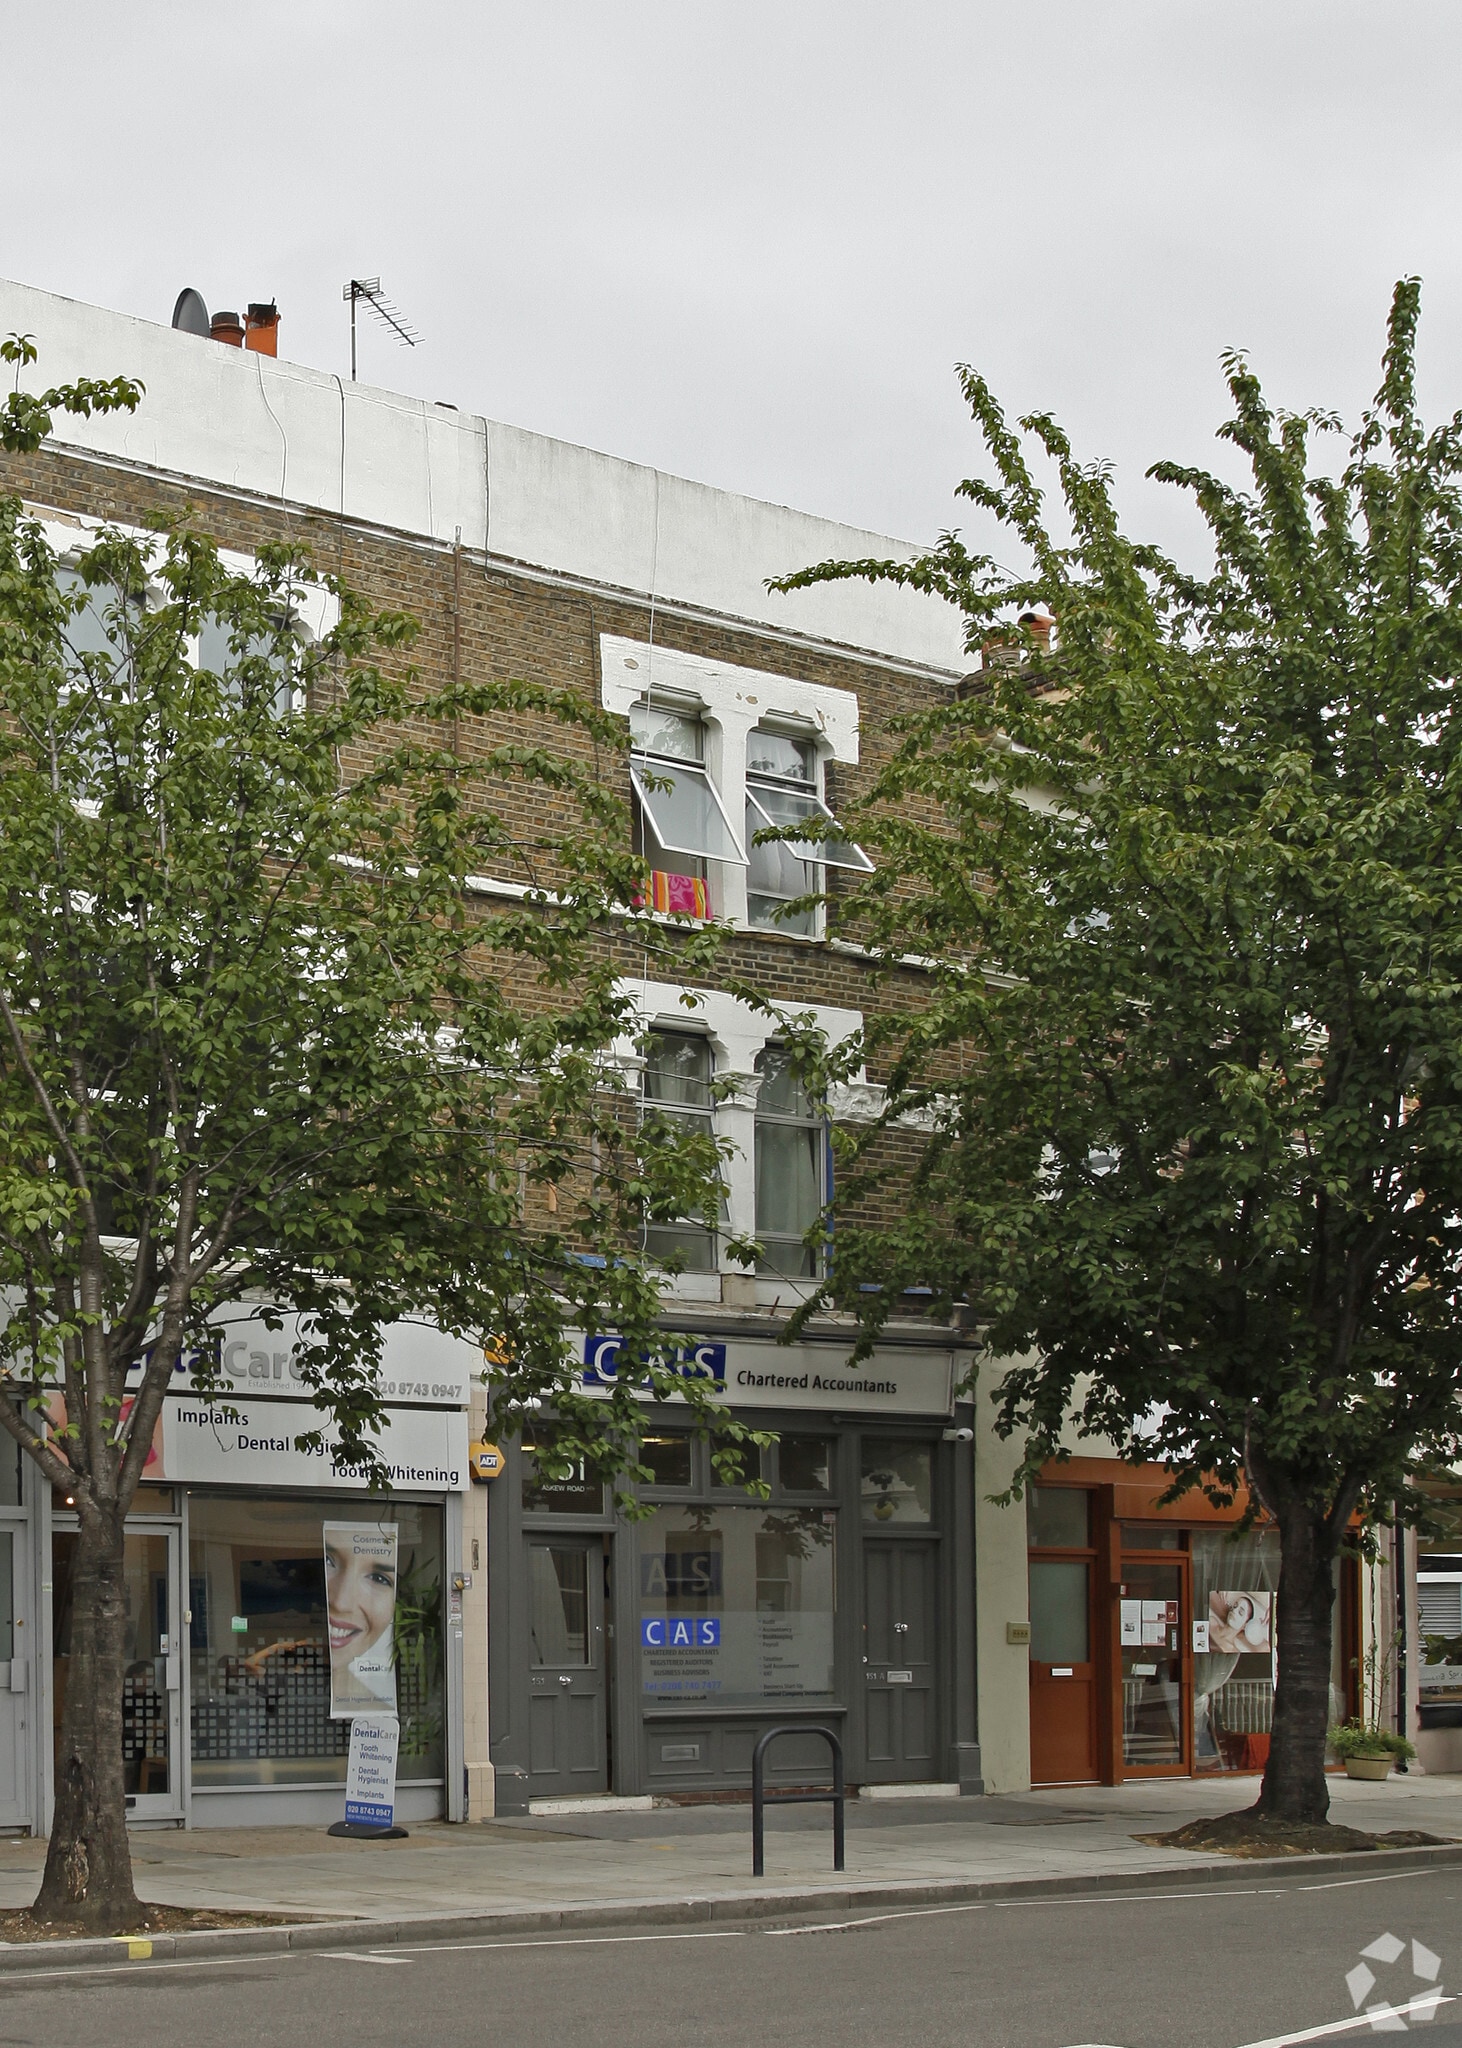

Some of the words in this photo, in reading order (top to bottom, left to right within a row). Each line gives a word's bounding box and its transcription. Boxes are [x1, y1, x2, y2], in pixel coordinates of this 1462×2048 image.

[248, 1380, 289, 1389] Established
[737, 1370, 808, 1388] Chartered
[812, 1375, 897, 1394] Accountants
[375, 1381, 396, 1394] 20
[399, 1382, 429, 1396] 8743
[431, 1383, 462, 1398] 0947
[177, 1408, 249, 1427] Implants
[238, 1435, 289, 1451] Dental
[480, 1456, 497, 1466] ADT
[541, 1484, 565, 1492] ASKEW
[353, 1546, 392, 1556] Dentistry
[646, 1621, 715, 1645] CAS
[355, 1728, 397, 1739] DentalCare
[360, 1744, 379, 1752] Tooth
[359, 1752, 393, 1763] Whitening
[358, 1766, 379, 1775] Dental
[357, 1775, 389, 1785] Hygienist
[356, 1789, 385, 1799] Implants
[347, 1805, 359, 1813] 020
[359, 1807, 375, 1815] 8743
